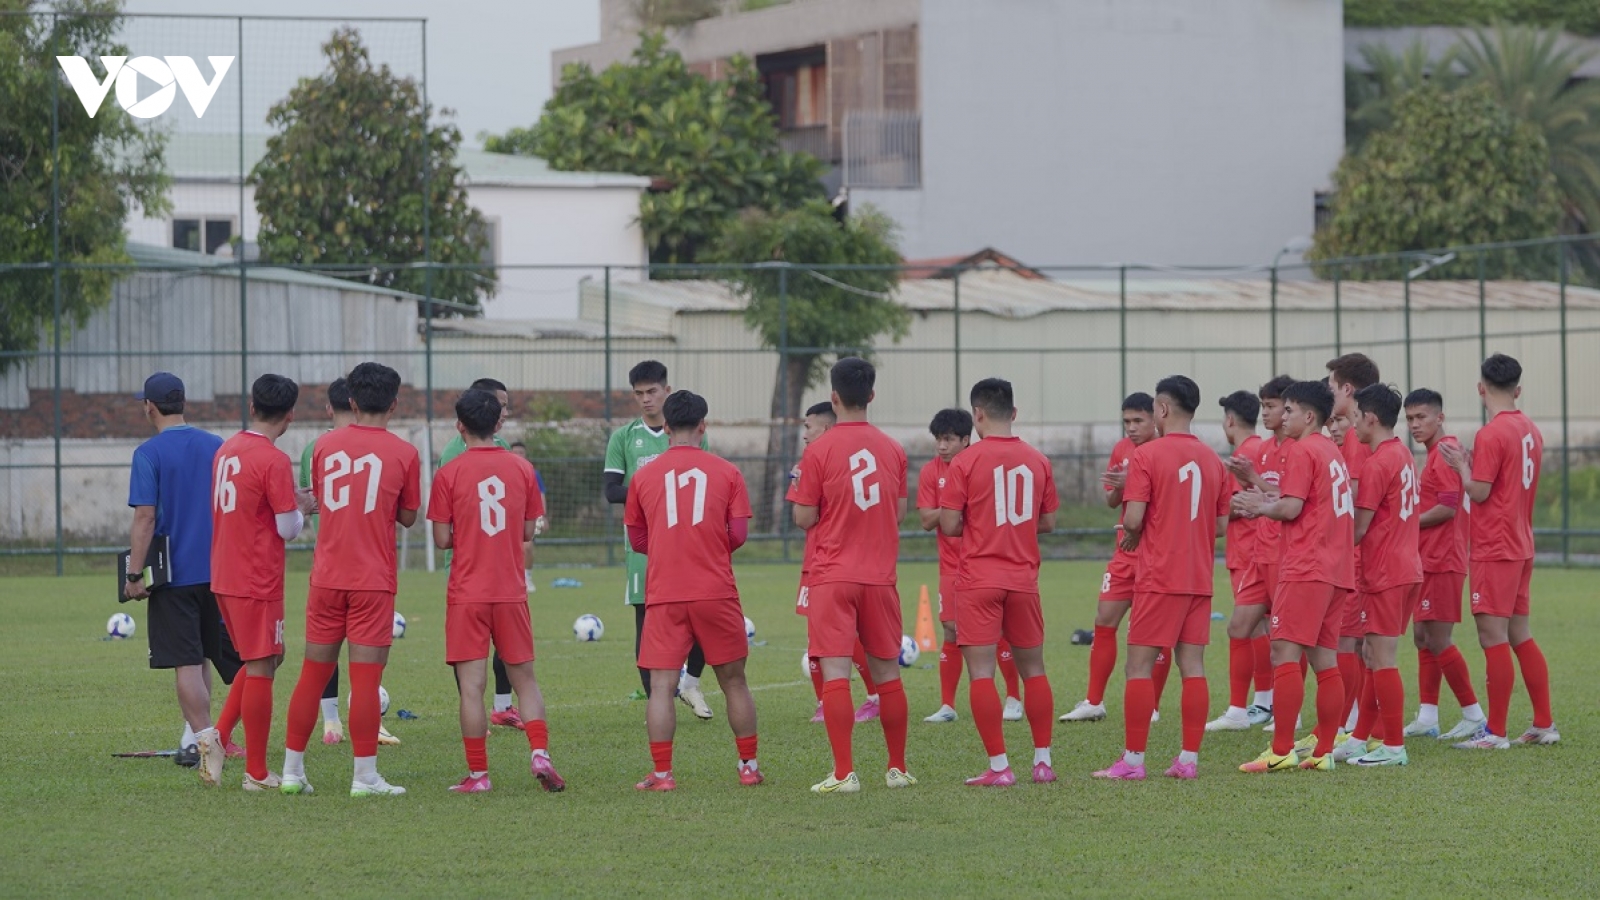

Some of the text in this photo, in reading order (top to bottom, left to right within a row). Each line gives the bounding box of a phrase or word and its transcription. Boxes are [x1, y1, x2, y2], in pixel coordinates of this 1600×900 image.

[214, 454, 241, 514] 16
[323, 450, 383, 514] 27
[849, 449, 880, 511] 2
[1178, 460, 1201, 521] 7
[1521, 432, 1534, 490] 6
[477, 475, 506, 537] 8
[664, 467, 708, 528] 17
[993, 464, 1034, 527] 10
